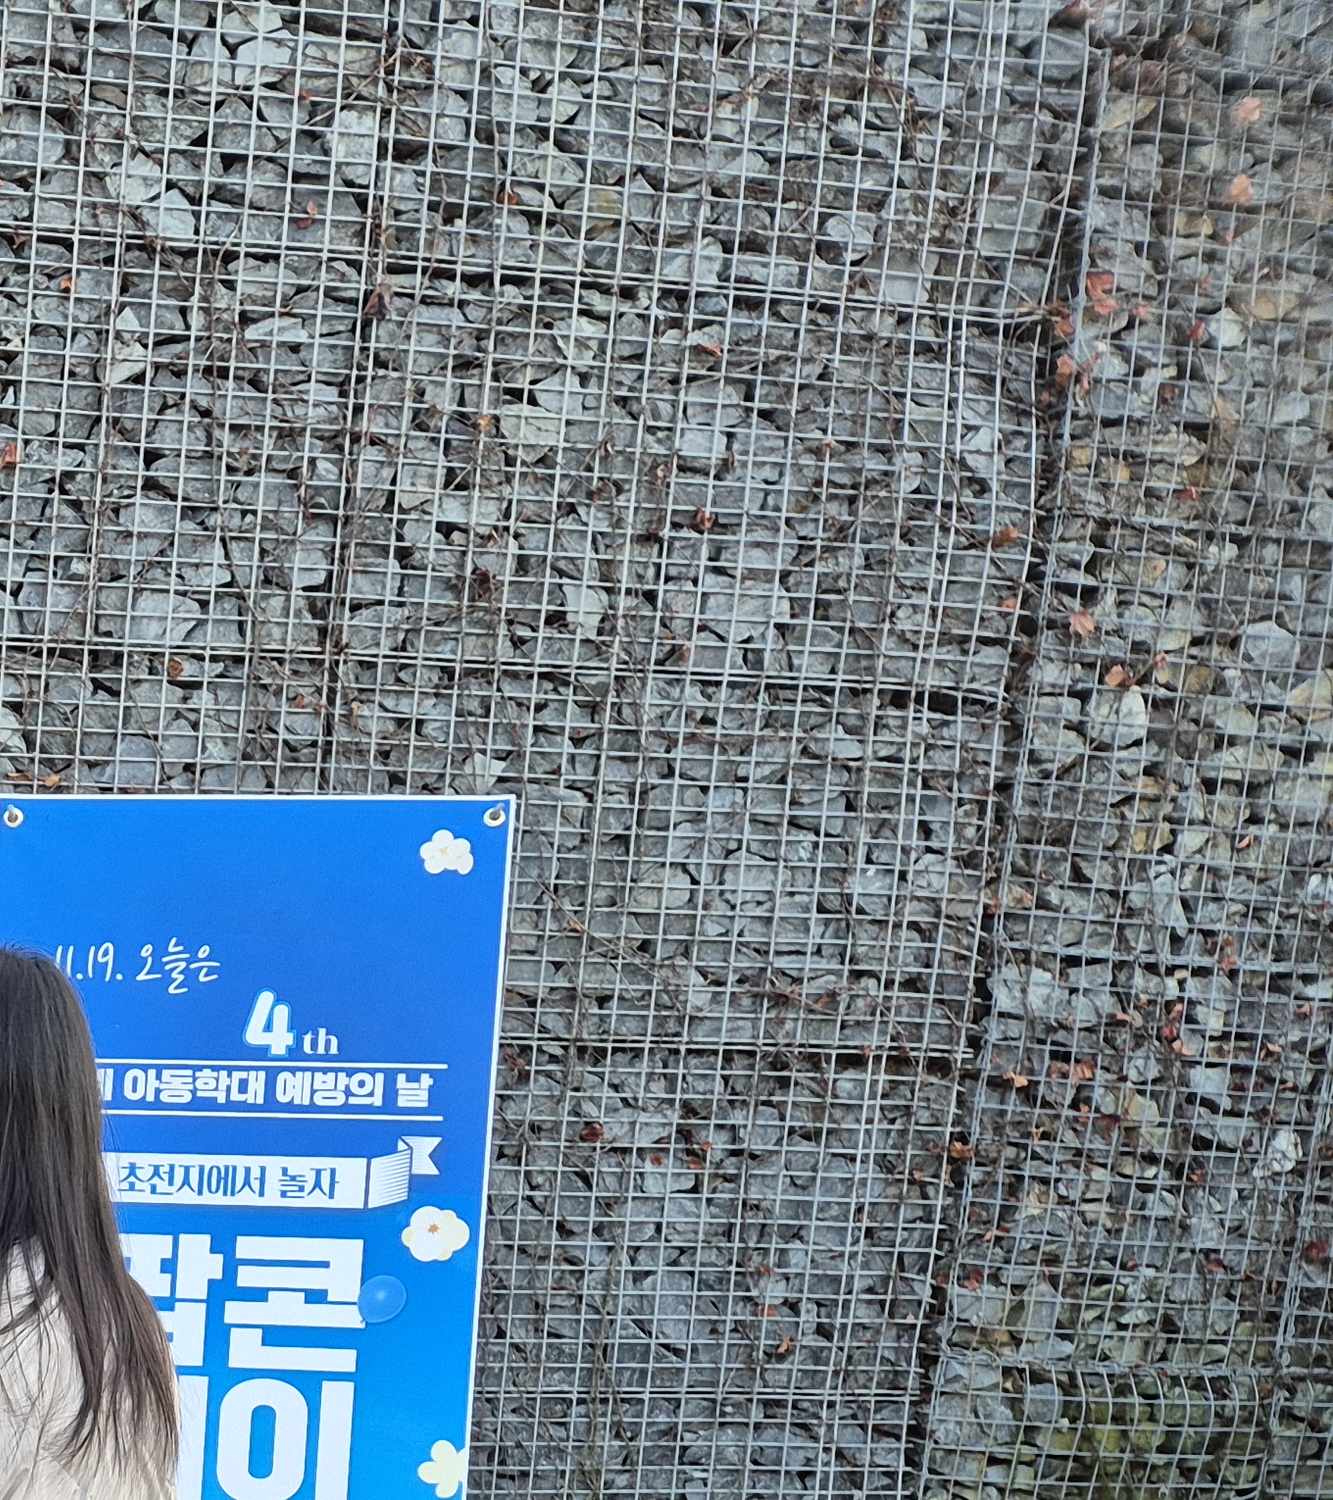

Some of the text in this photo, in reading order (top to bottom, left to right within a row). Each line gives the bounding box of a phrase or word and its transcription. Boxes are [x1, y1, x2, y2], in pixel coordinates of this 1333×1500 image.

[135, 936, 221, 994] 오늘은
[123, 1068, 266, 1105] 아동학대
[276, 1070, 385, 1107] 예방의
[396, 1072, 433, 1108] 날
[117, 1161, 339, 1200] 초전지에서 놀자
